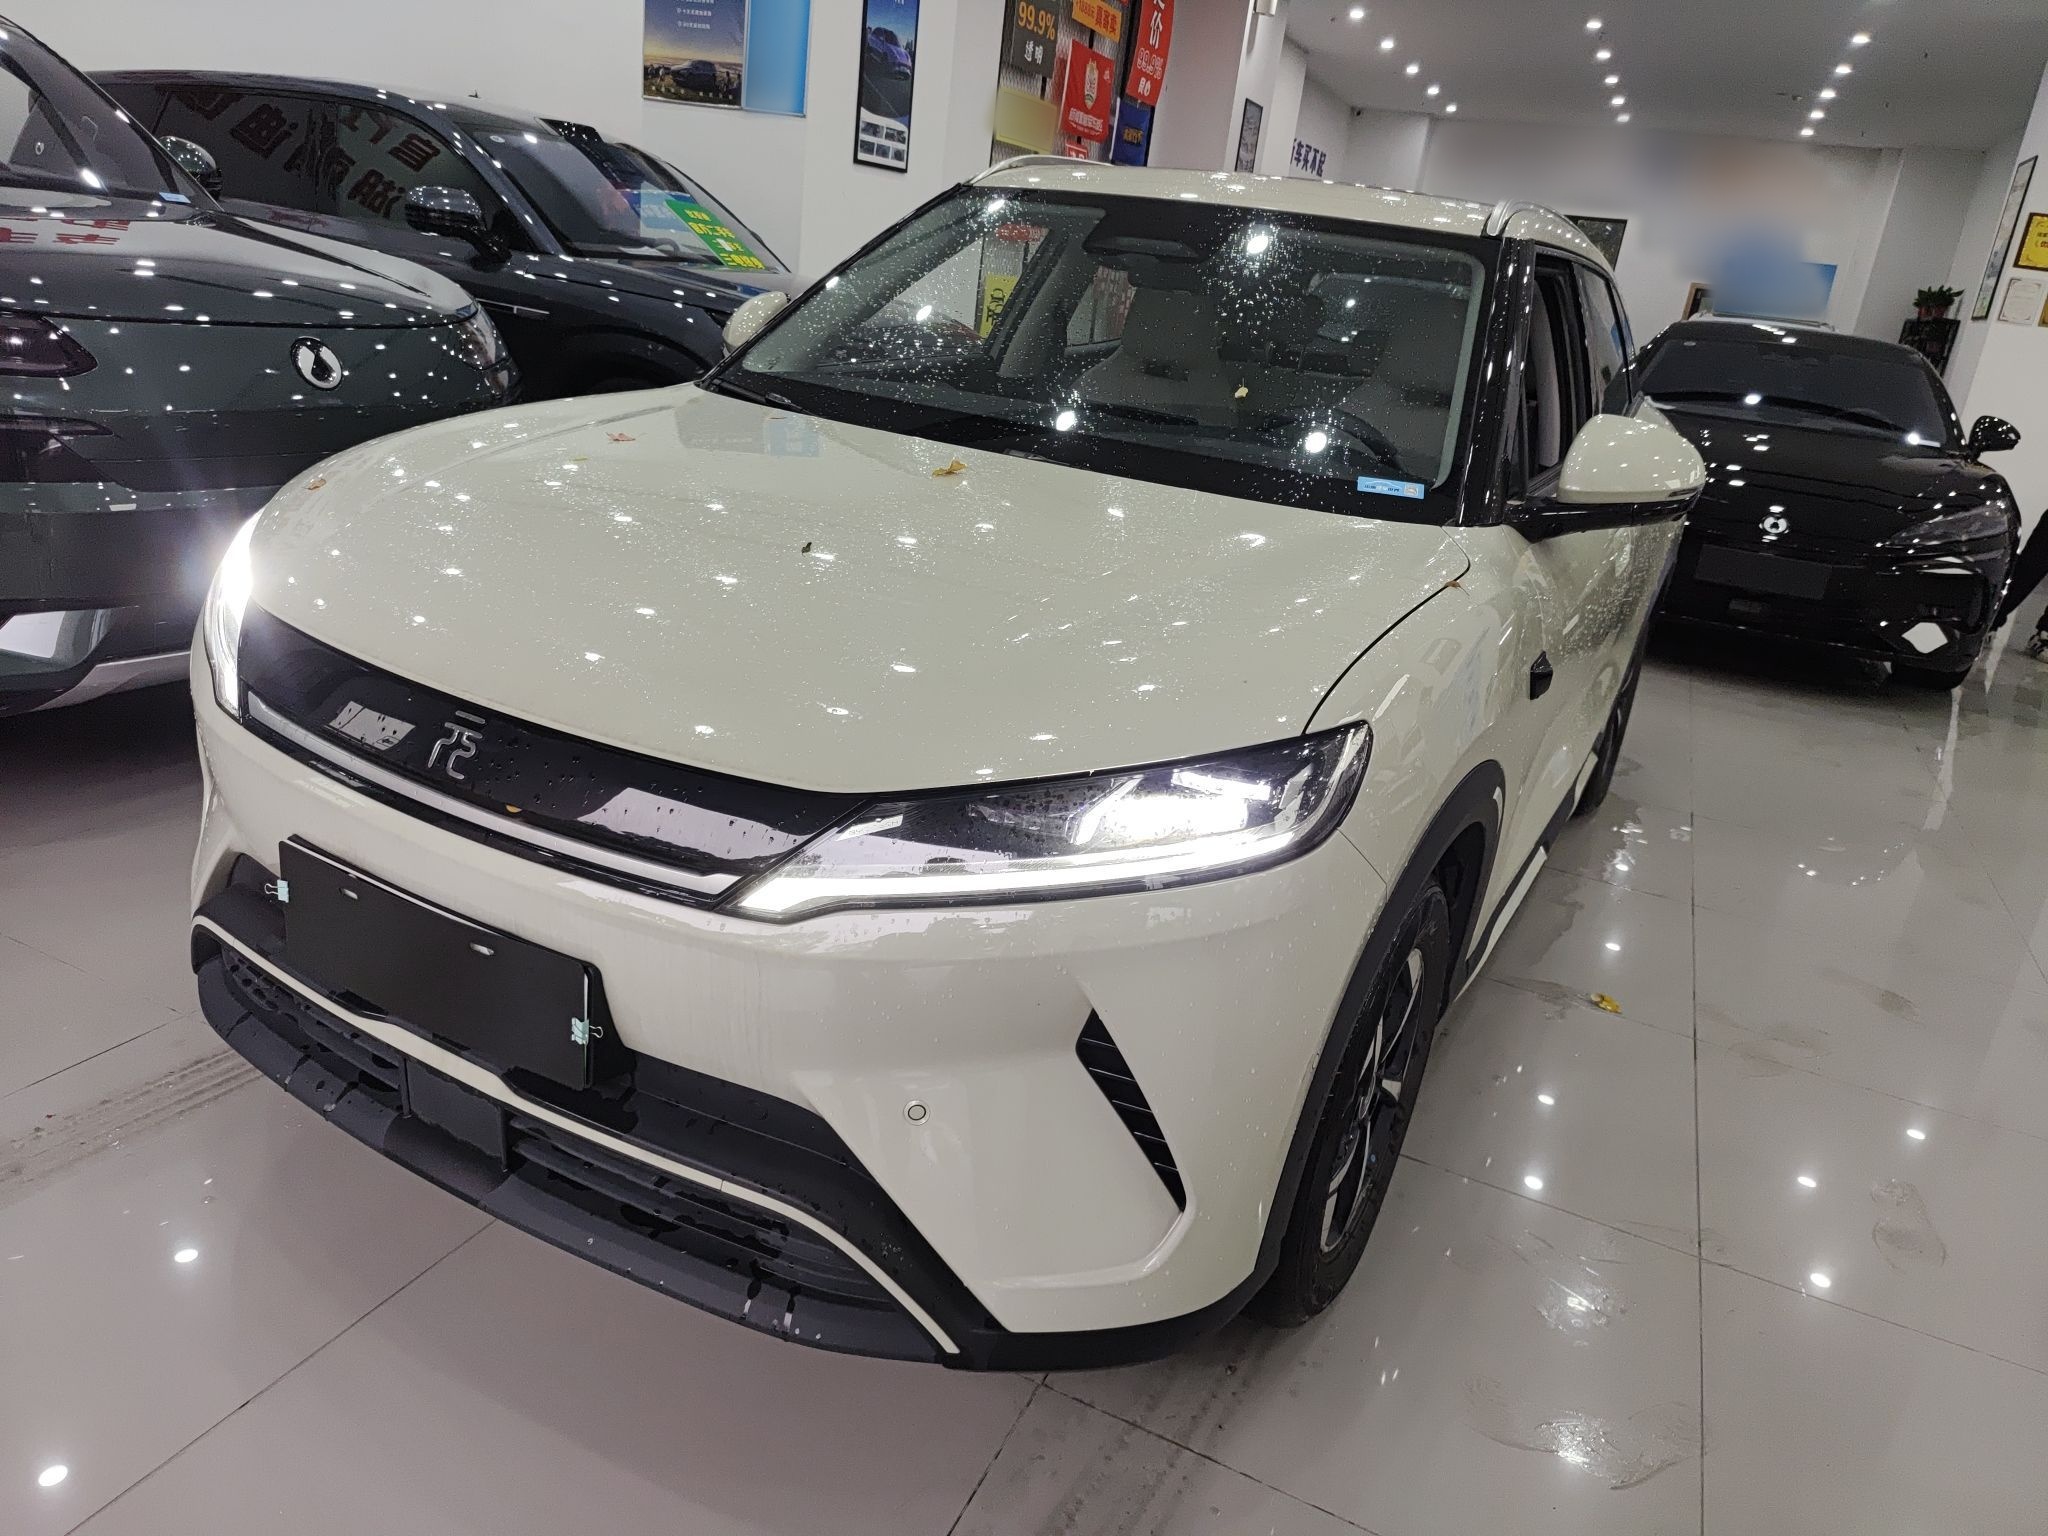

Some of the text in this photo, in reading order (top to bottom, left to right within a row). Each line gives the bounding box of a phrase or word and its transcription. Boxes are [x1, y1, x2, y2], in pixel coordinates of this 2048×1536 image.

[1017, 2, 1056, 40] 99.9%
[1023, 40, 1044, 65] 透明
[1137, 47, 1164, 80] 99.9%
[427, 709, 488, 781] 元
